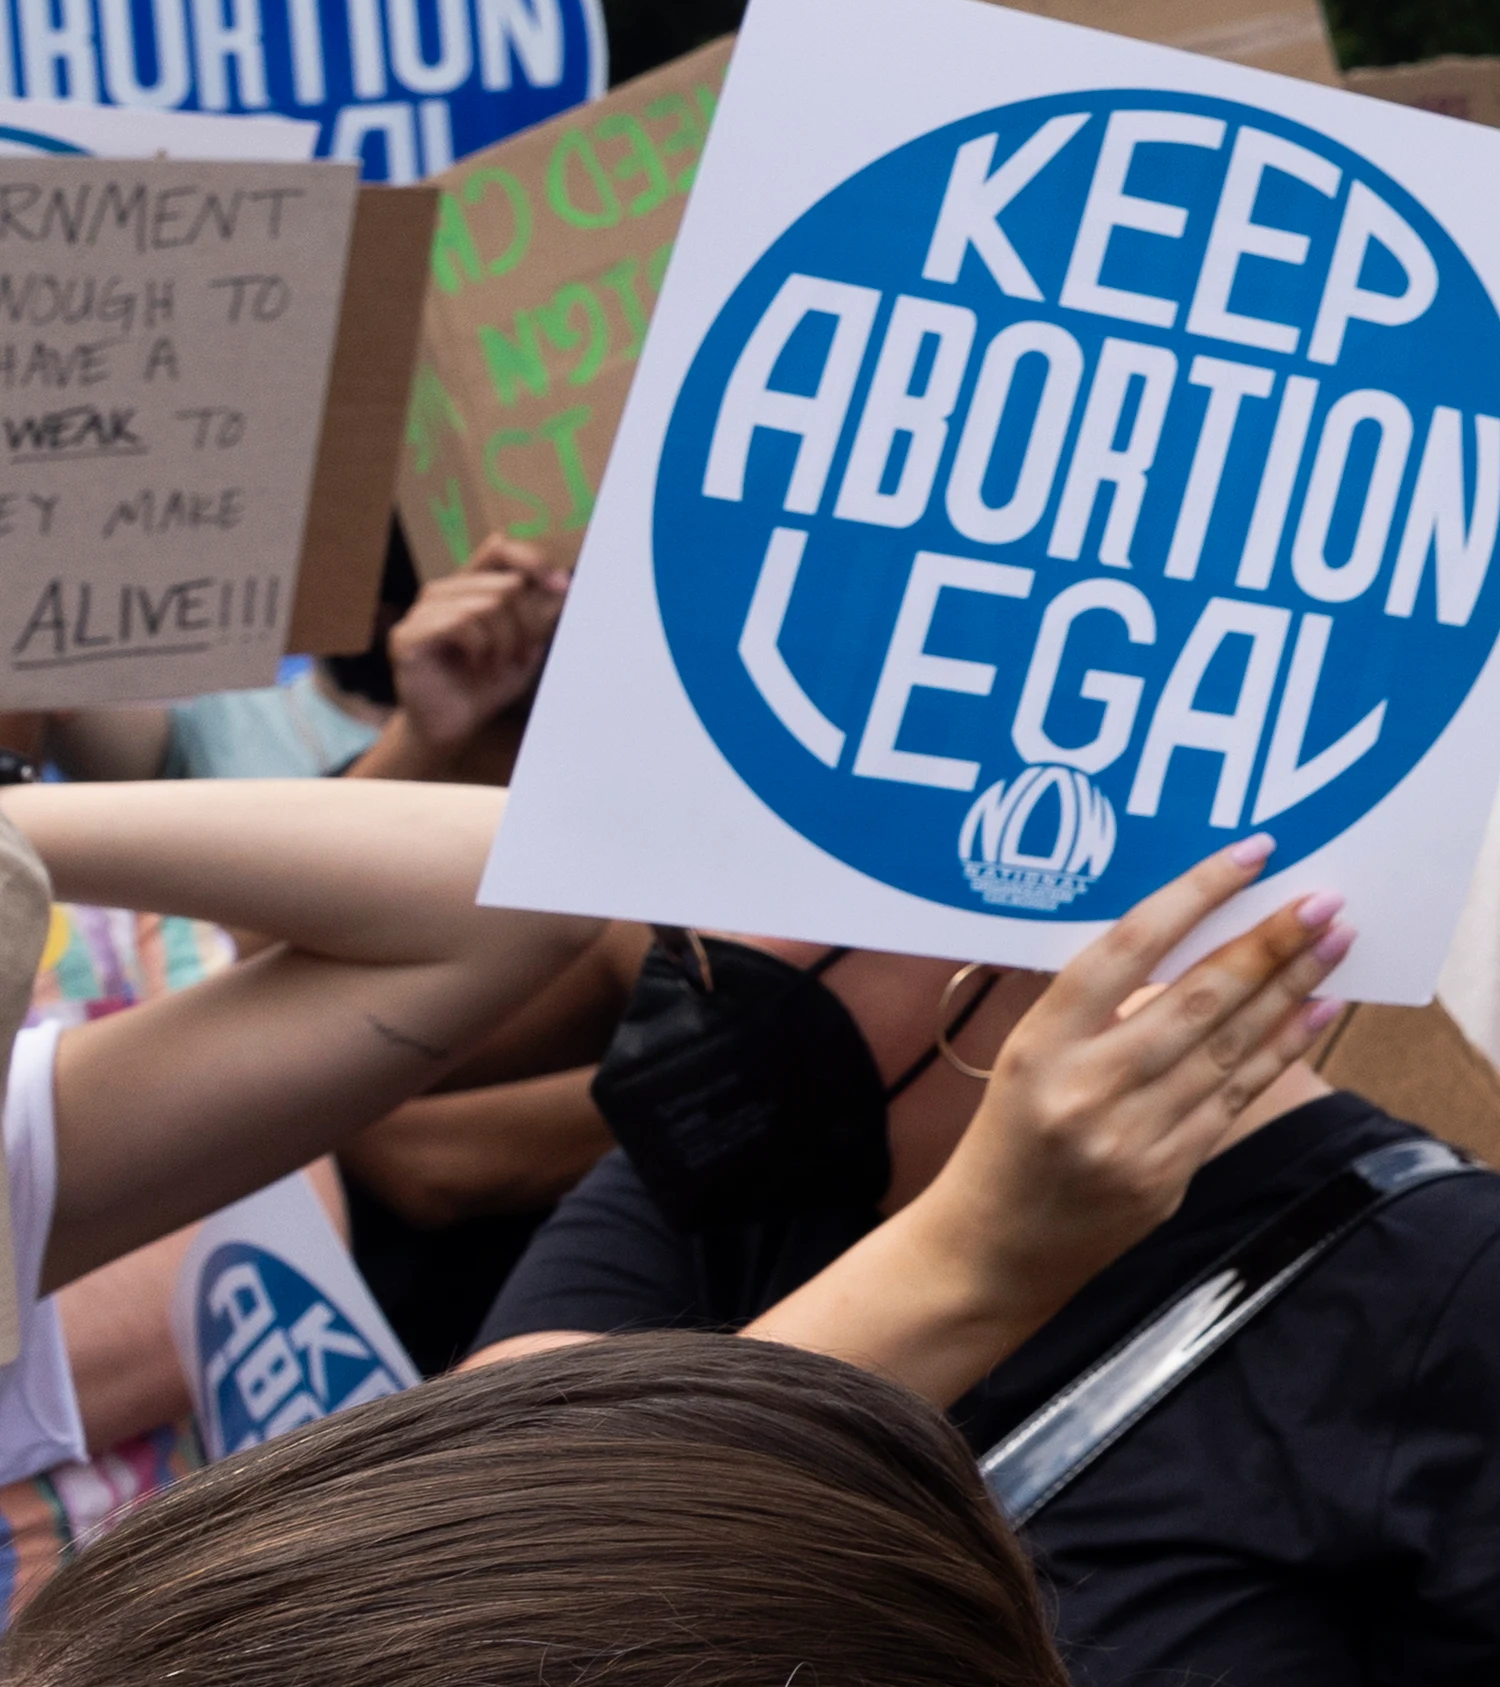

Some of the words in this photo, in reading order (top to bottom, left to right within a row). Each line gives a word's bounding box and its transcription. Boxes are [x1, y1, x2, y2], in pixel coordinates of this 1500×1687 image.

[921, 109, 1440, 367] KEEP
[207, 273, 291, 327] TO
[142, 335, 180, 382] A
[3, 406, 142, 450] WEAK
[176, 406, 247, 451] TO
[483, 405, 600, 540] IS
[102, 486, 245, 539] MAKE
[11, 575, 280, 653] ALIVE!!!
[737, 526, 1390, 830] LEGAL
[957, 763, 1118, 880] NOW
